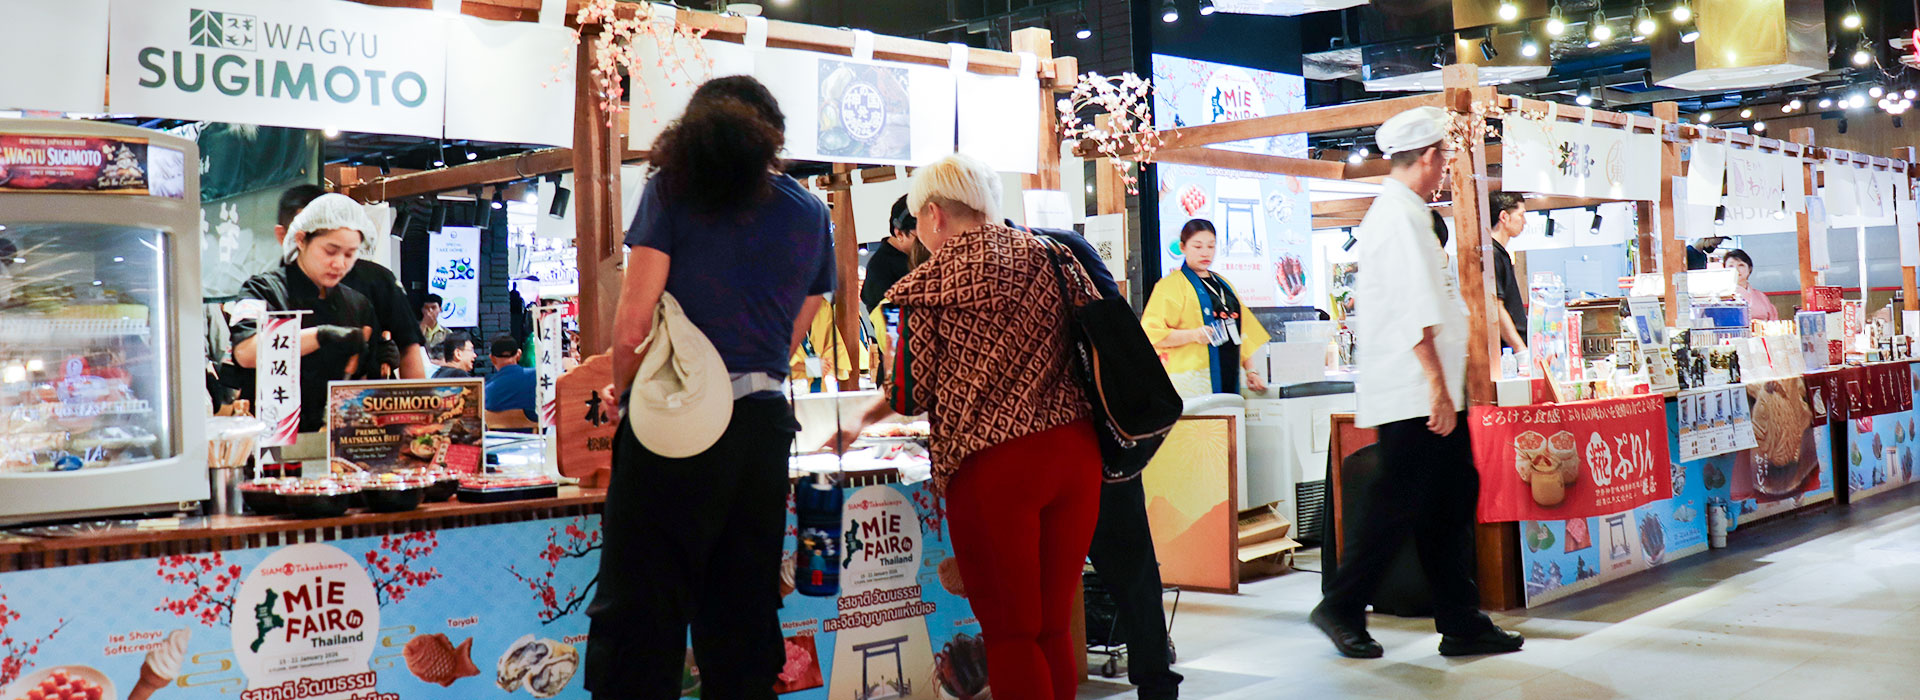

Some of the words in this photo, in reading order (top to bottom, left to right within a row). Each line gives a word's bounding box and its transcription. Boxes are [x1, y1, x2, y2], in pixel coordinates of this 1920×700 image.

[263, 21, 379, 58] WAGYU
[138, 46, 428, 108] SUGIMOTO
[3, 147, 46, 165] WAGYU
[47, 147, 102, 167] SUGIMOTO
[271, 333, 290, 404] 松阪牛
[362, 395, 442, 412] SUGIMOTO
[339, 436, 383, 445] MATSUSAKA
[383, 433, 400, 443] BEEF
[355, 428, 387, 437] PREMIUM
[864, 535, 903, 562] FAIR
[879, 553, 914, 567] Thailand
[260, 568, 282, 577] SIAM
[296, 562, 349, 574] Takashimaya
[838, 590, 871, 611] รสชาติ
[871, 584, 921, 606] วัฒนธรรม
[286, 608, 346, 643] FAIR
[447, 615, 479, 628] Taiyaki
[781, 617, 818, 630] Matsusaka
[109, 634, 125, 644] Ise
[128, 630, 163, 641] Shoyu
[311, 631, 364, 649] Thailand
[104, 642, 163, 657] Softcream
[298, 672, 376, 699] วัฒนธรรม
